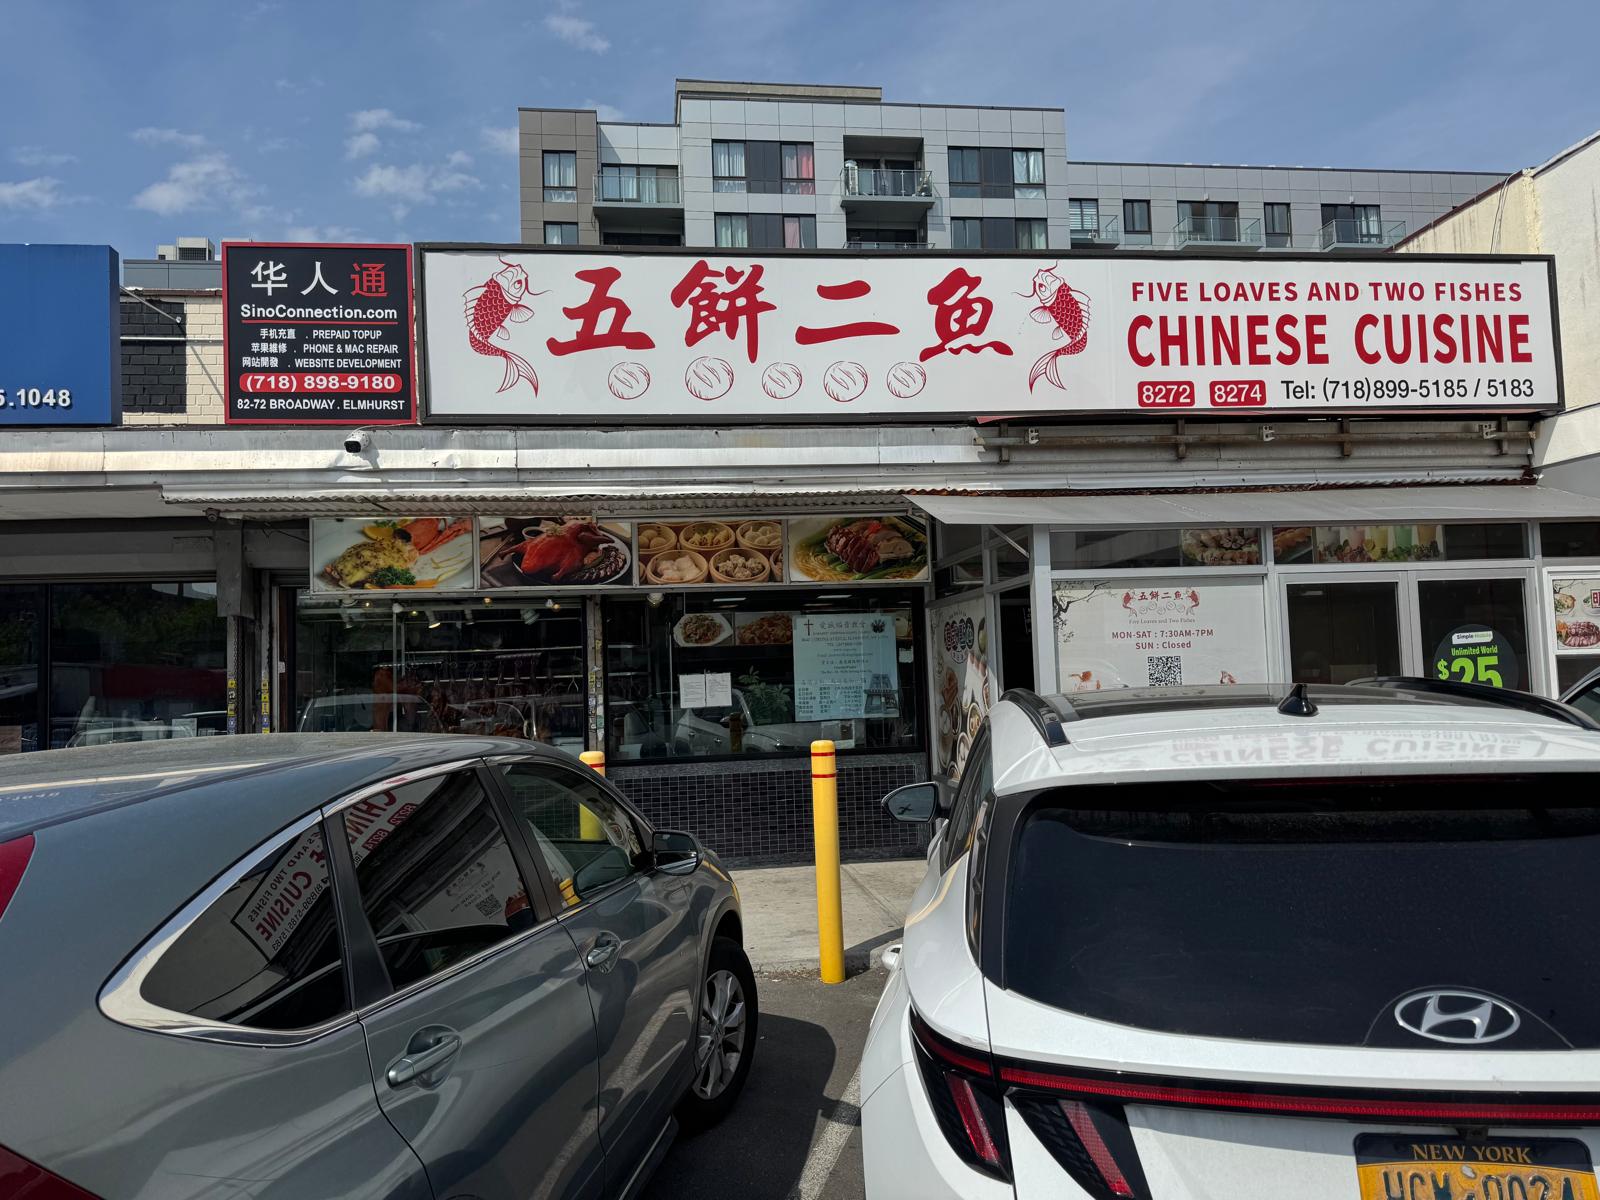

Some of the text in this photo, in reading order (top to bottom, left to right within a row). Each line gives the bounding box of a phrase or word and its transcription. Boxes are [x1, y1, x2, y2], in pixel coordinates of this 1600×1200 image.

[251, 261, 388, 297] 华人通
[1132, 282, 1522, 302] FIVE LOAVES AND TWO FISHES
[240, 304, 397, 321] SinoConnection.com
[546, 259, 1013, 363] 五餅二魚
[313, 330, 350, 340] PREPAID
[352, 330, 382, 340] TOPUP
[1127, 313, 1532, 367] CHINESE CUISINE
[303, 344, 335, 354] PHONE
[336, 344, 343, 353] &
[345, 344, 364, 354] MAC
[366, 344, 398, 354] REPAIR
[295, 359, 334, 368] WEBSITE
[336, 359, 402, 369] DEVELOPMENT
[246, 375, 394, 392] (718) 898-9180
[1142, 385, 1191, 403] 8272
[1214, 384, 1262, 402] 8274
[1281, 380, 1315, 399] Tel:
[1323, 377, 1468, 401] (718)899-5185
[1487, 379, 1534, 397] 5183
[237, 399, 405, 410] 82-72 BROADWAY ELMHURST
[1112, 630, 1151, 639] MON-SAT
[1160, 629, 1214, 638] 7:30AM-7PM
[1135, 641, 1153, 650] SUN
[1162, 640, 1191, 649] Closed
[1451, 645, 1498, 656] Unlimited World
[1411, 1144, 1532, 1163] NEW YORK
